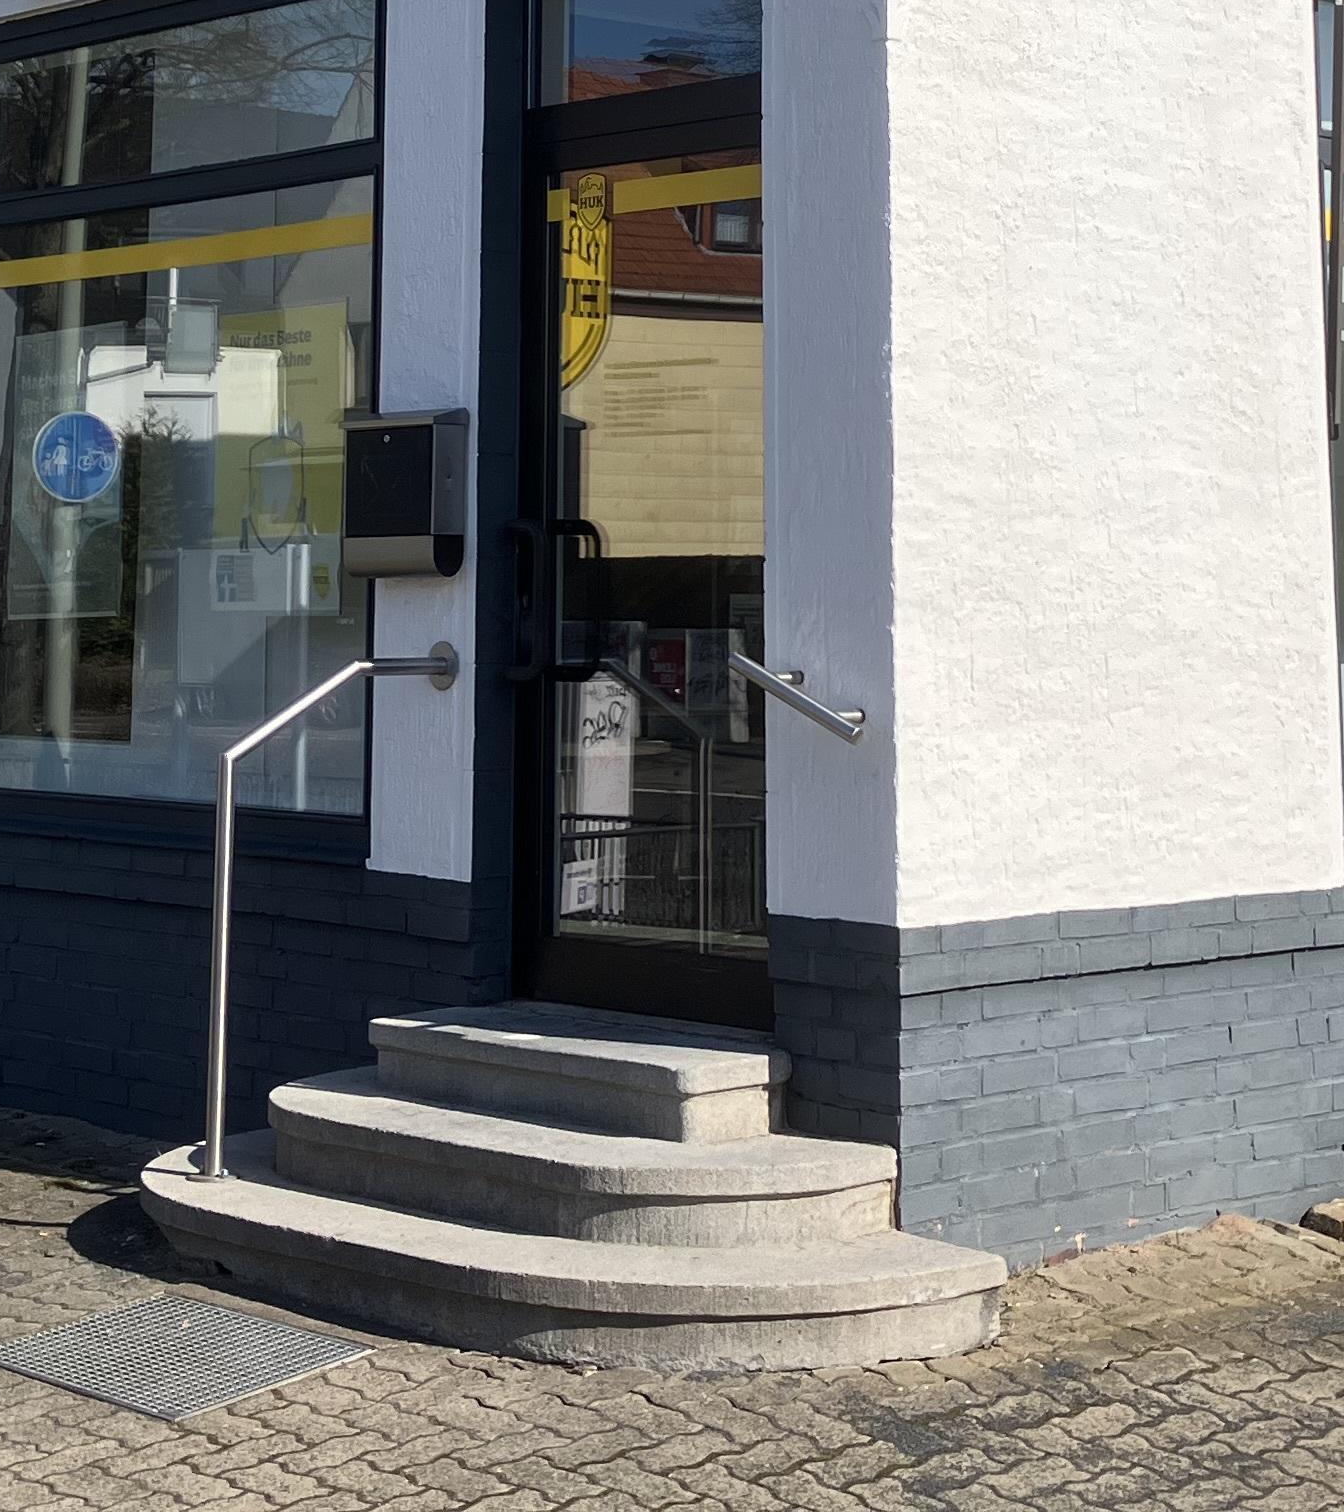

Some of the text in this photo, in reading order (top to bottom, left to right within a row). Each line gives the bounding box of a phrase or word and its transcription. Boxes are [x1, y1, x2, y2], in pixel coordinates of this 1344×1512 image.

[579, 195, 604, 209] HUK
[253, 331, 275, 347] das
[277, 329, 312, 346] Beste
